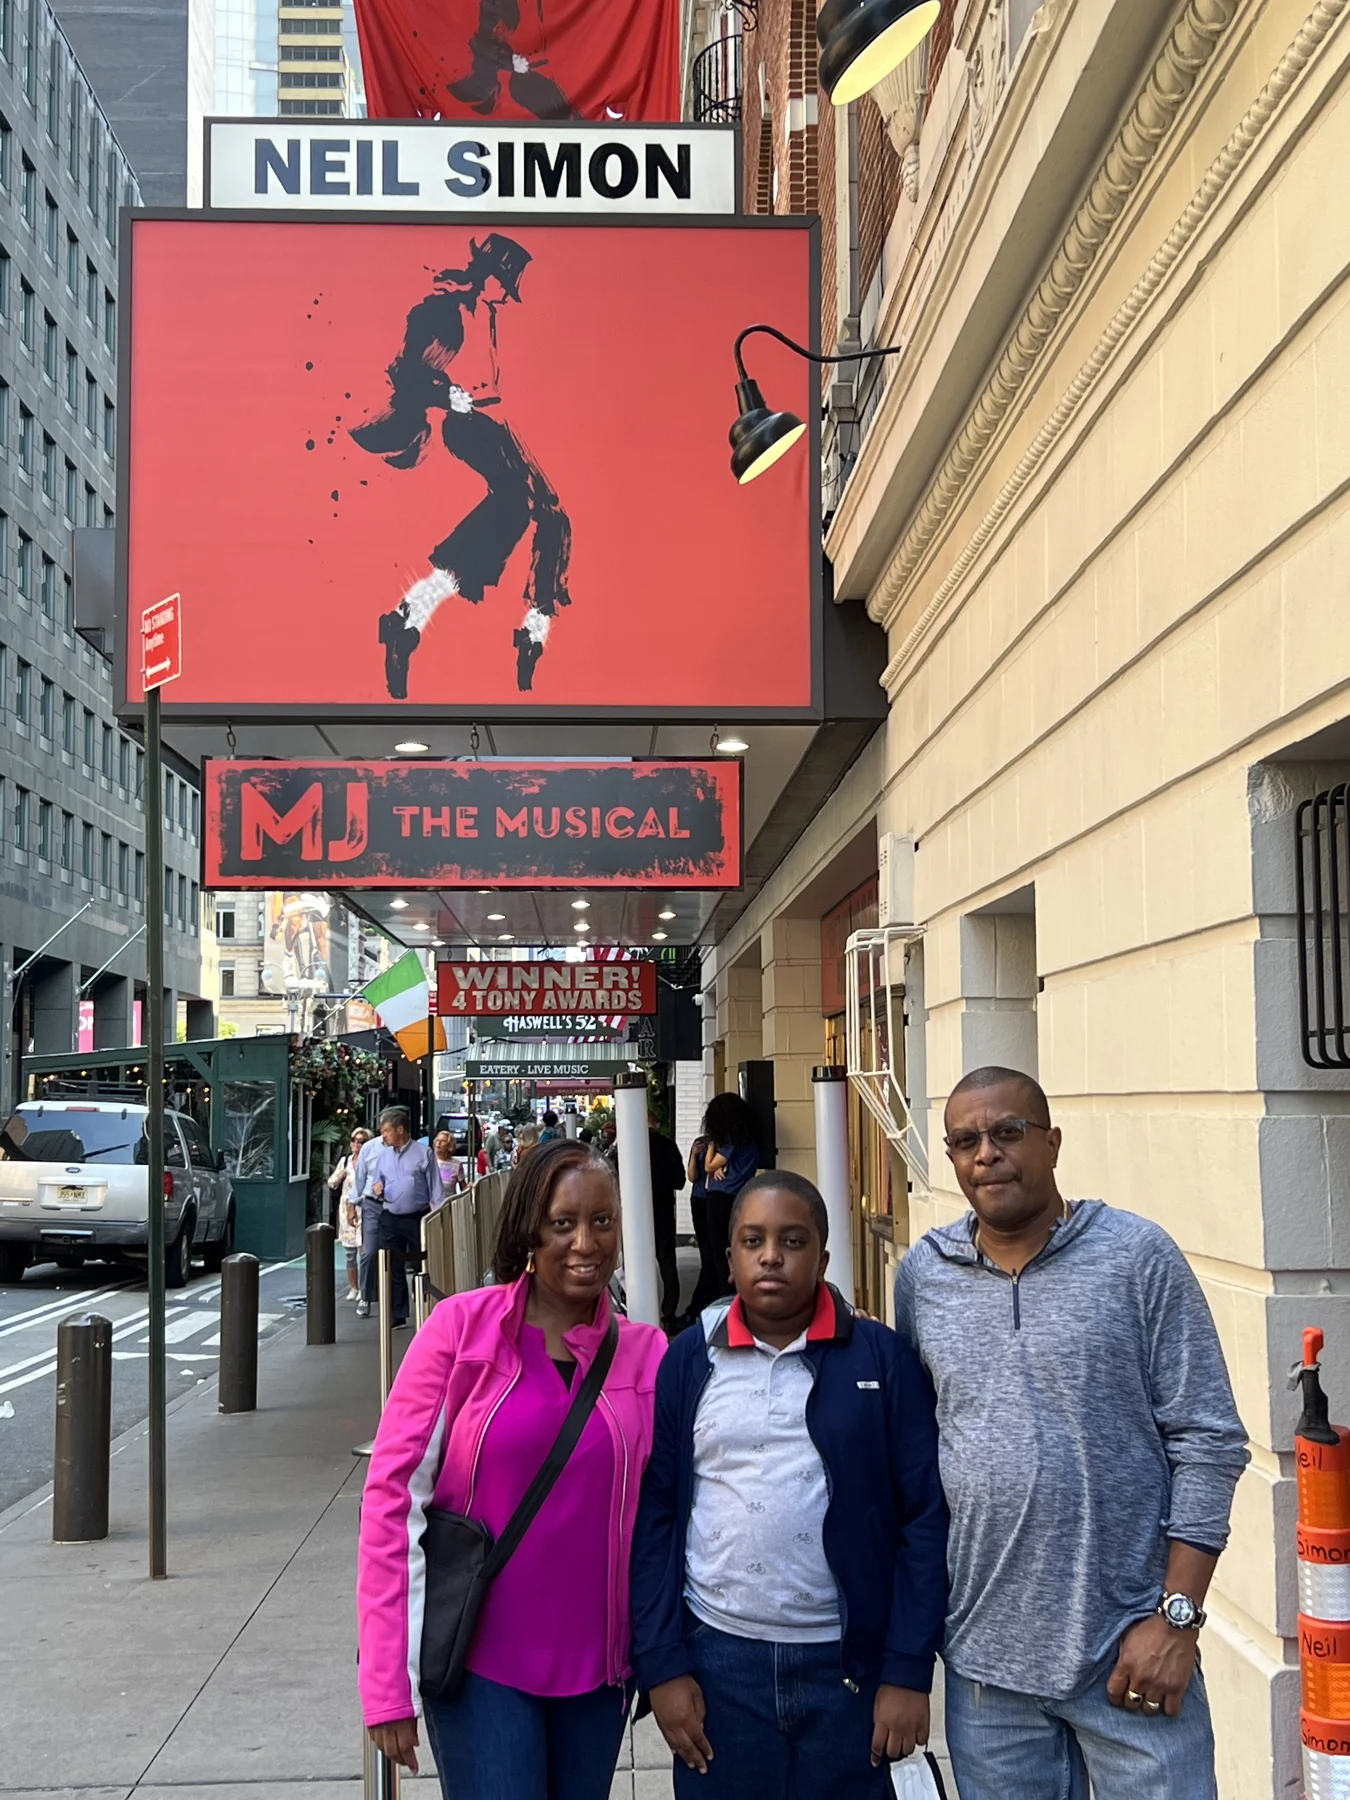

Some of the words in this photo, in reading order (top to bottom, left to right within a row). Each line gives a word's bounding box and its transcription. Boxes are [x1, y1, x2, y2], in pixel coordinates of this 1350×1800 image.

[254, 139, 419, 196] NEIL
[444, 141, 691, 198] SIMON
[240, 781, 369, 862] MJ
[392, 805, 479, 838] THE
[495, 805, 691, 840] MUSICAL
[451, 966, 641, 989] WINNER!
[451, 990, 467, 1011] 4
[472, 990, 539, 1011] TONY
[542, 990, 642, 1011] AWARDS
[503, 1015, 572, 1032] HASWELL'S
[480, 1065, 520, 1075] EATERY
[527, 1065, 551, 1075] LIVE
[553, 1065, 589, 1075] MUSIC
[1302, 1632, 1336, 1657] Neil
